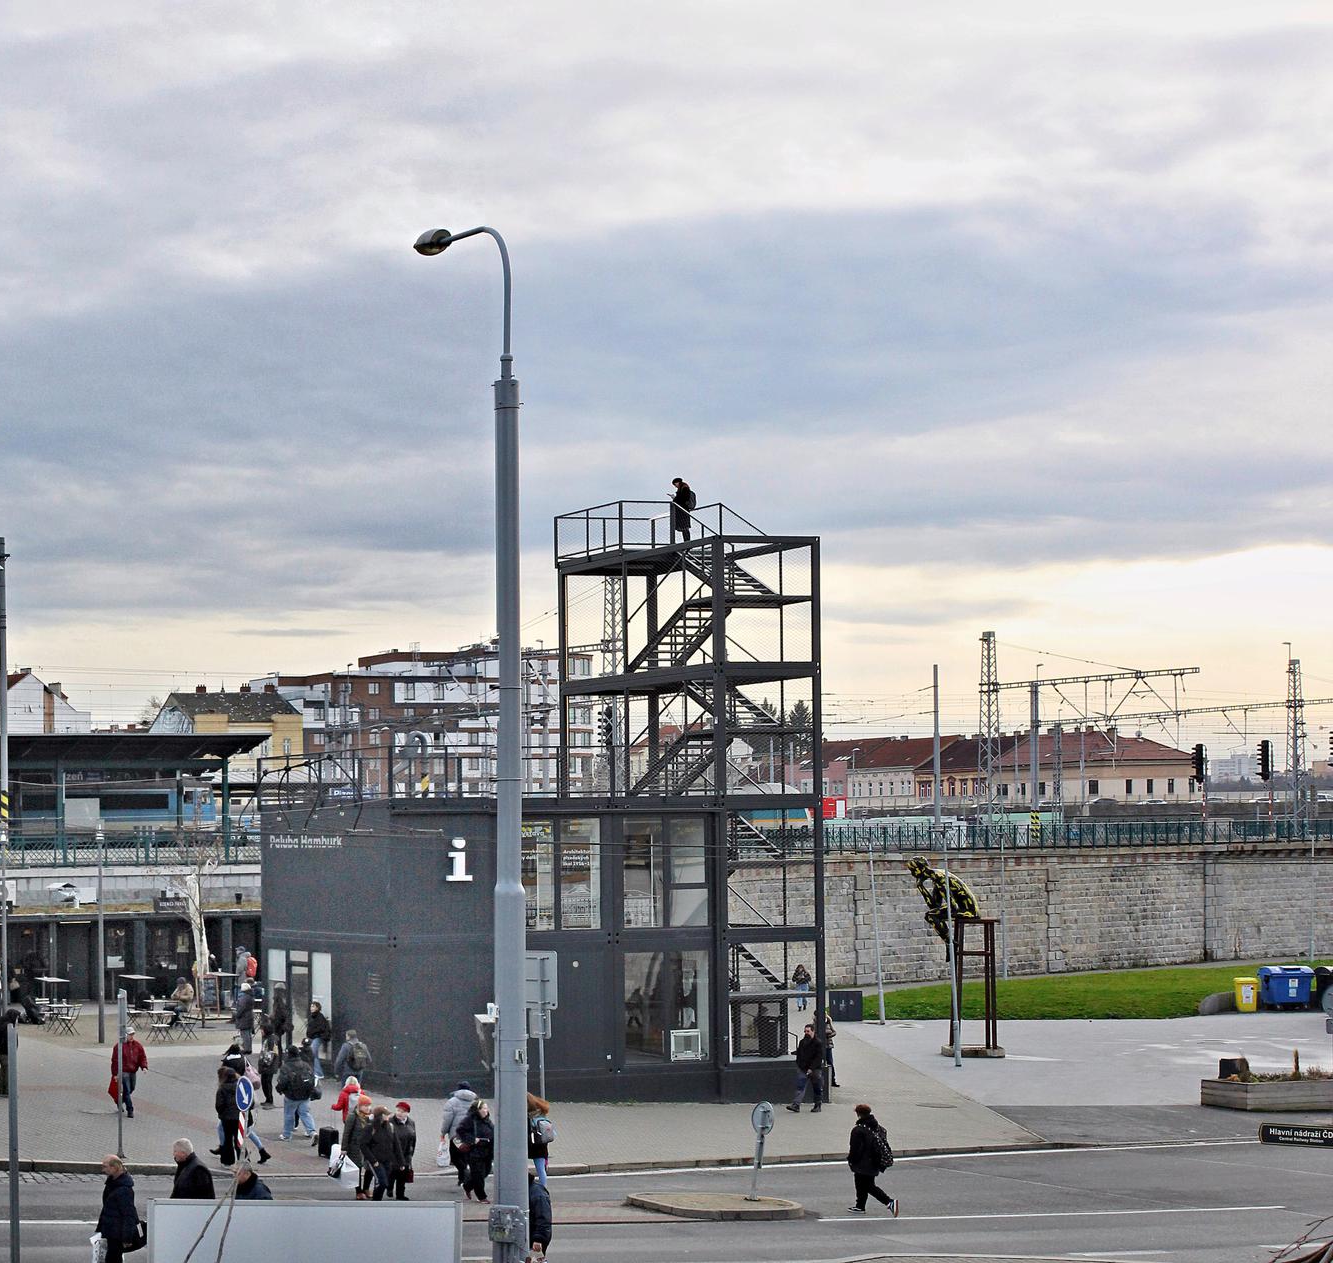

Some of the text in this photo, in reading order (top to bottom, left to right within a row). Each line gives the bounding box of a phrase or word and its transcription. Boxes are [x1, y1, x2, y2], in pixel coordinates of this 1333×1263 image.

[300, 834, 343, 849] Hamburk
[445, 836, 474, 882] i
[1269, 1128, 1293, 1136] Hlavní
[1293, 1129, 1321, 1138] nádraží
